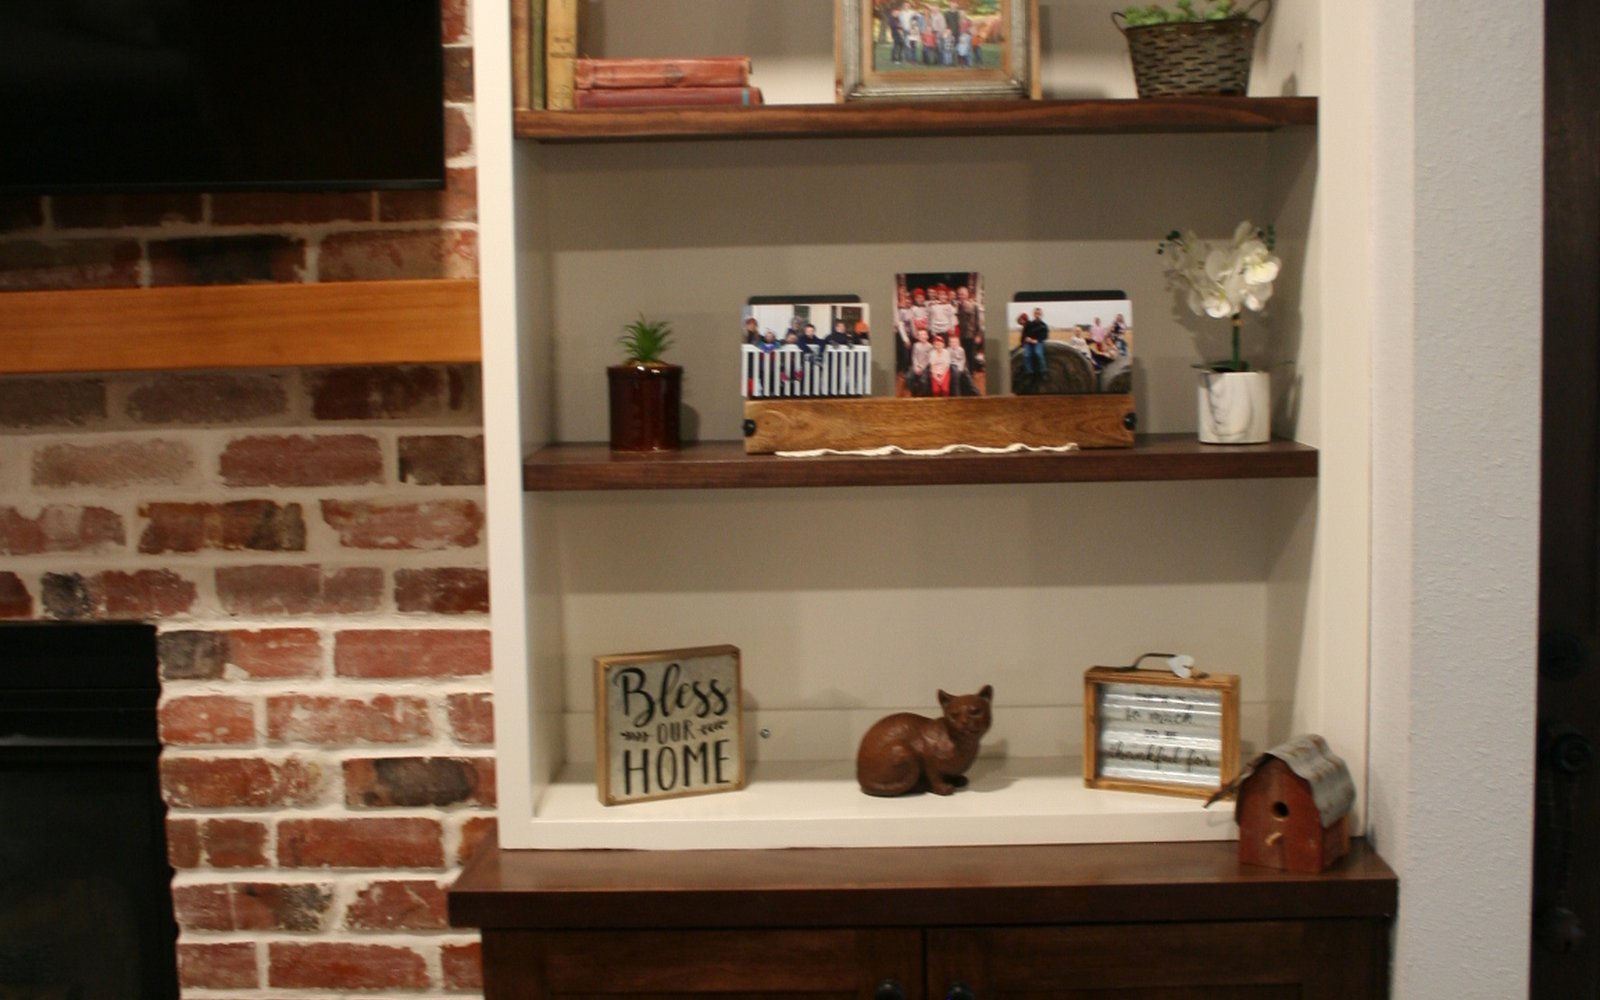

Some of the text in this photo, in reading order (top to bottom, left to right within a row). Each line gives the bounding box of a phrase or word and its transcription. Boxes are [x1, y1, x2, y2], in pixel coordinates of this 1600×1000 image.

[613, 663, 731, 728] Bless
[656, 719, 696, 745] OUR
[624, 738, 730, 795] HOME
